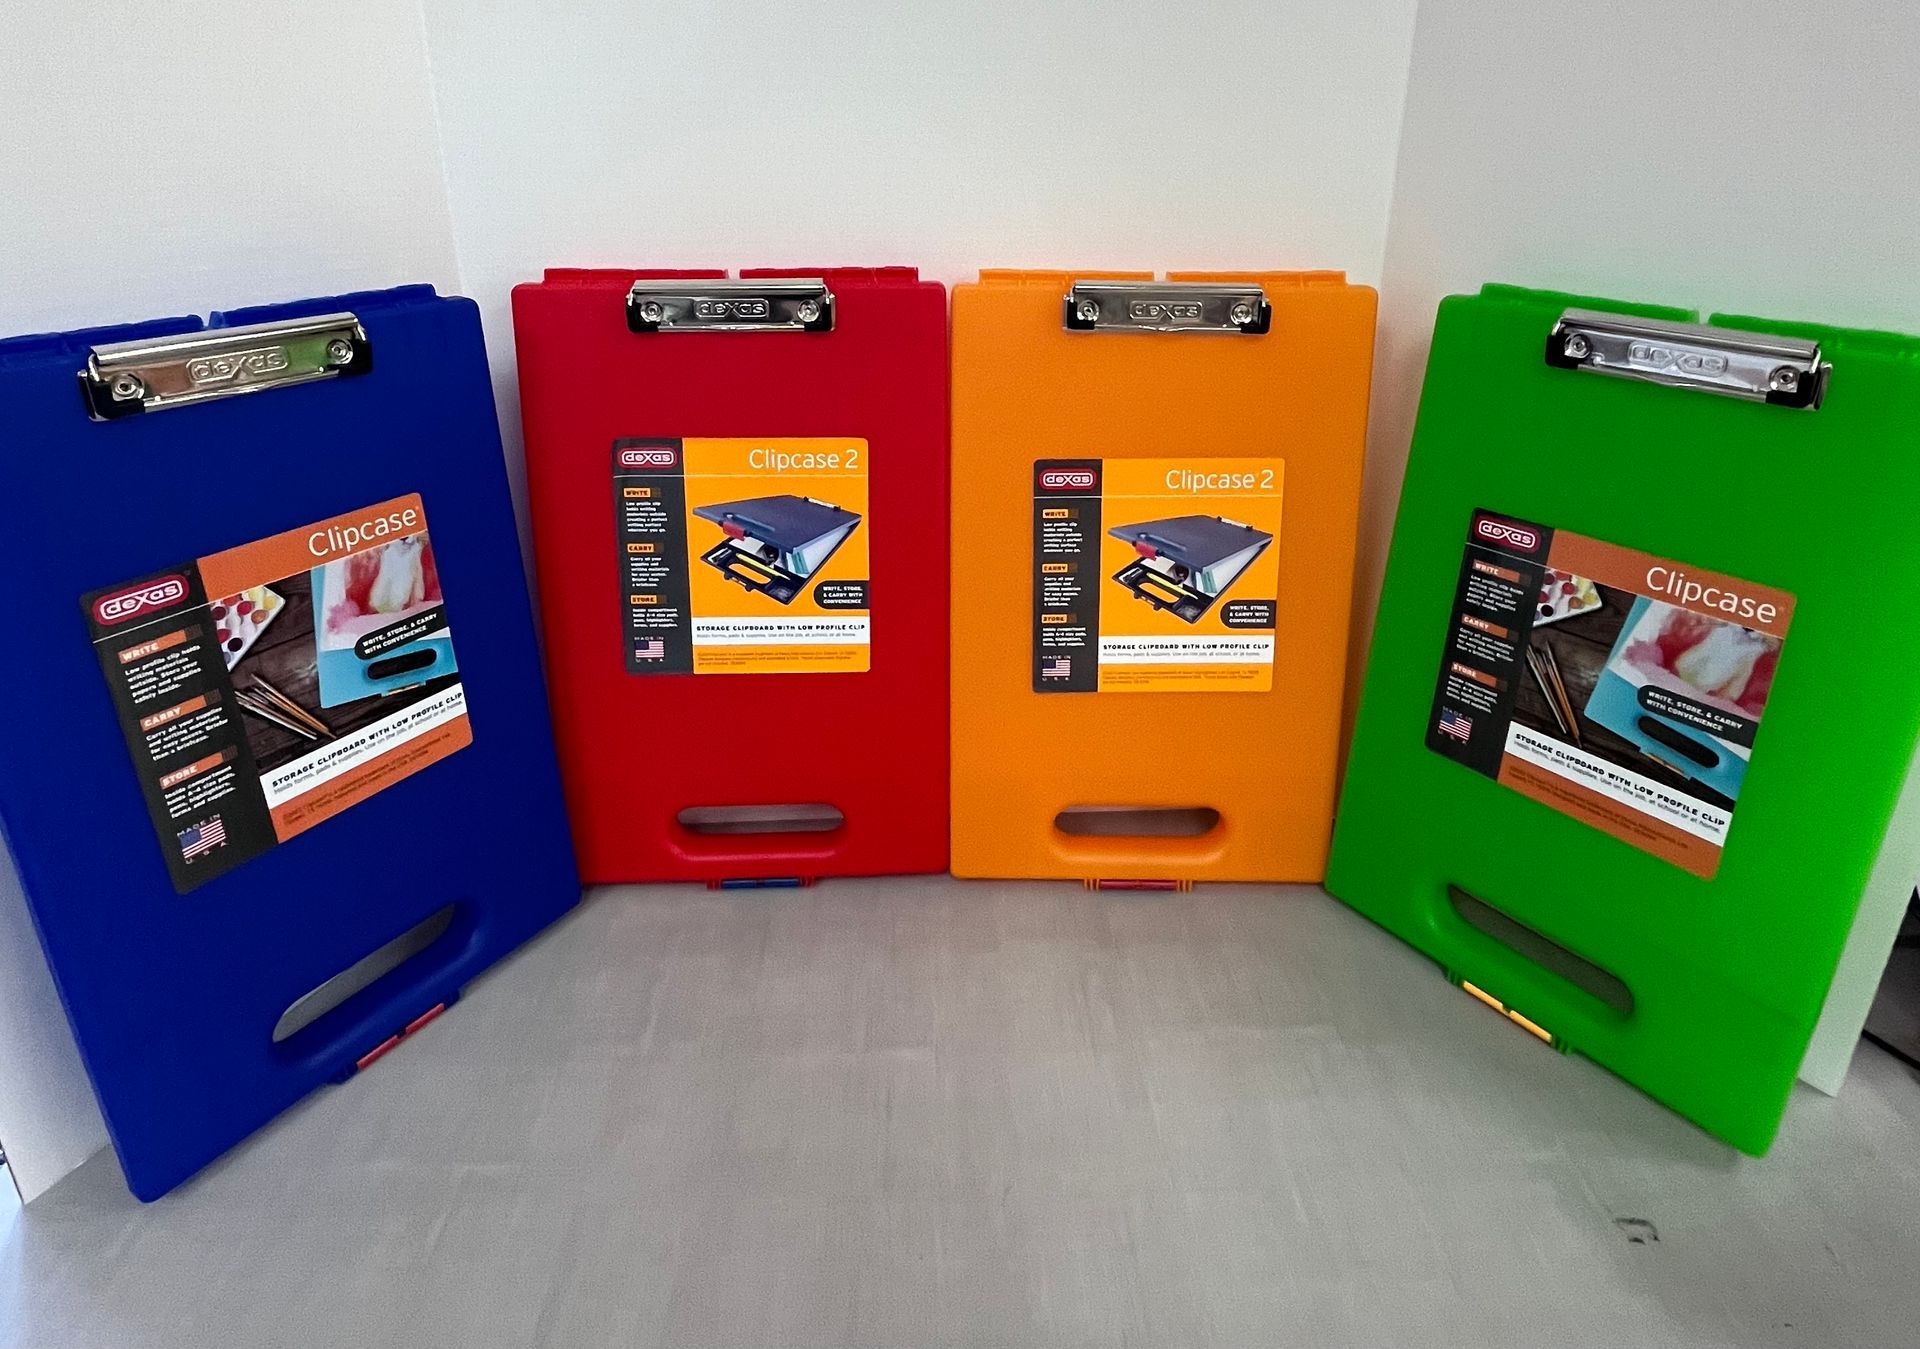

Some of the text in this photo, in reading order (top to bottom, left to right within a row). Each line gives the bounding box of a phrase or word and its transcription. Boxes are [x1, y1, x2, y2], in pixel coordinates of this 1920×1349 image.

[699, 301, 766, 316] dexas
[1134, 303, 1199, 317] dexas
[192, 351, 284, 381] dexas
[625, 452, 670, 461] dexas
[749, 449, 858, 472] Clipcase 2
[1046, 474, 1090, 484] dexas
[1166, 469, 1274, 493] Clipcase 2
[309, 509, 416, 556] Clipcase
[1481, 523, 1531, 544] dexas
[1475, 563, 1499, 575] WRITE
[107, 585, 178, 614] dexas
[1647, 567, 1776, 623] Clipcase
[1464, 616, 1489, 629] CARRY
[364, 625, 427, 654] WITH CONVENIENCE
[122, 642, 159, 661] WRITE
[1453, 664, 1476, 678] STORE
[144, 707, 181, 727] CARRY
[1646, 699, 1723, 731] WITH CONVENIENCE
[1714, 715, 1742, 729] CARRY
[272, 692, 462, 787] STORAGE CLIPBOARD WITH LOW PROFILE CLIP
[163, 766, 197, 786] STORE
[1516, 734, 1725, 825] STORAGE CLIPBOARD WITH LOW PROFILE CLIP
[177, 820, 206, 837] MADE
